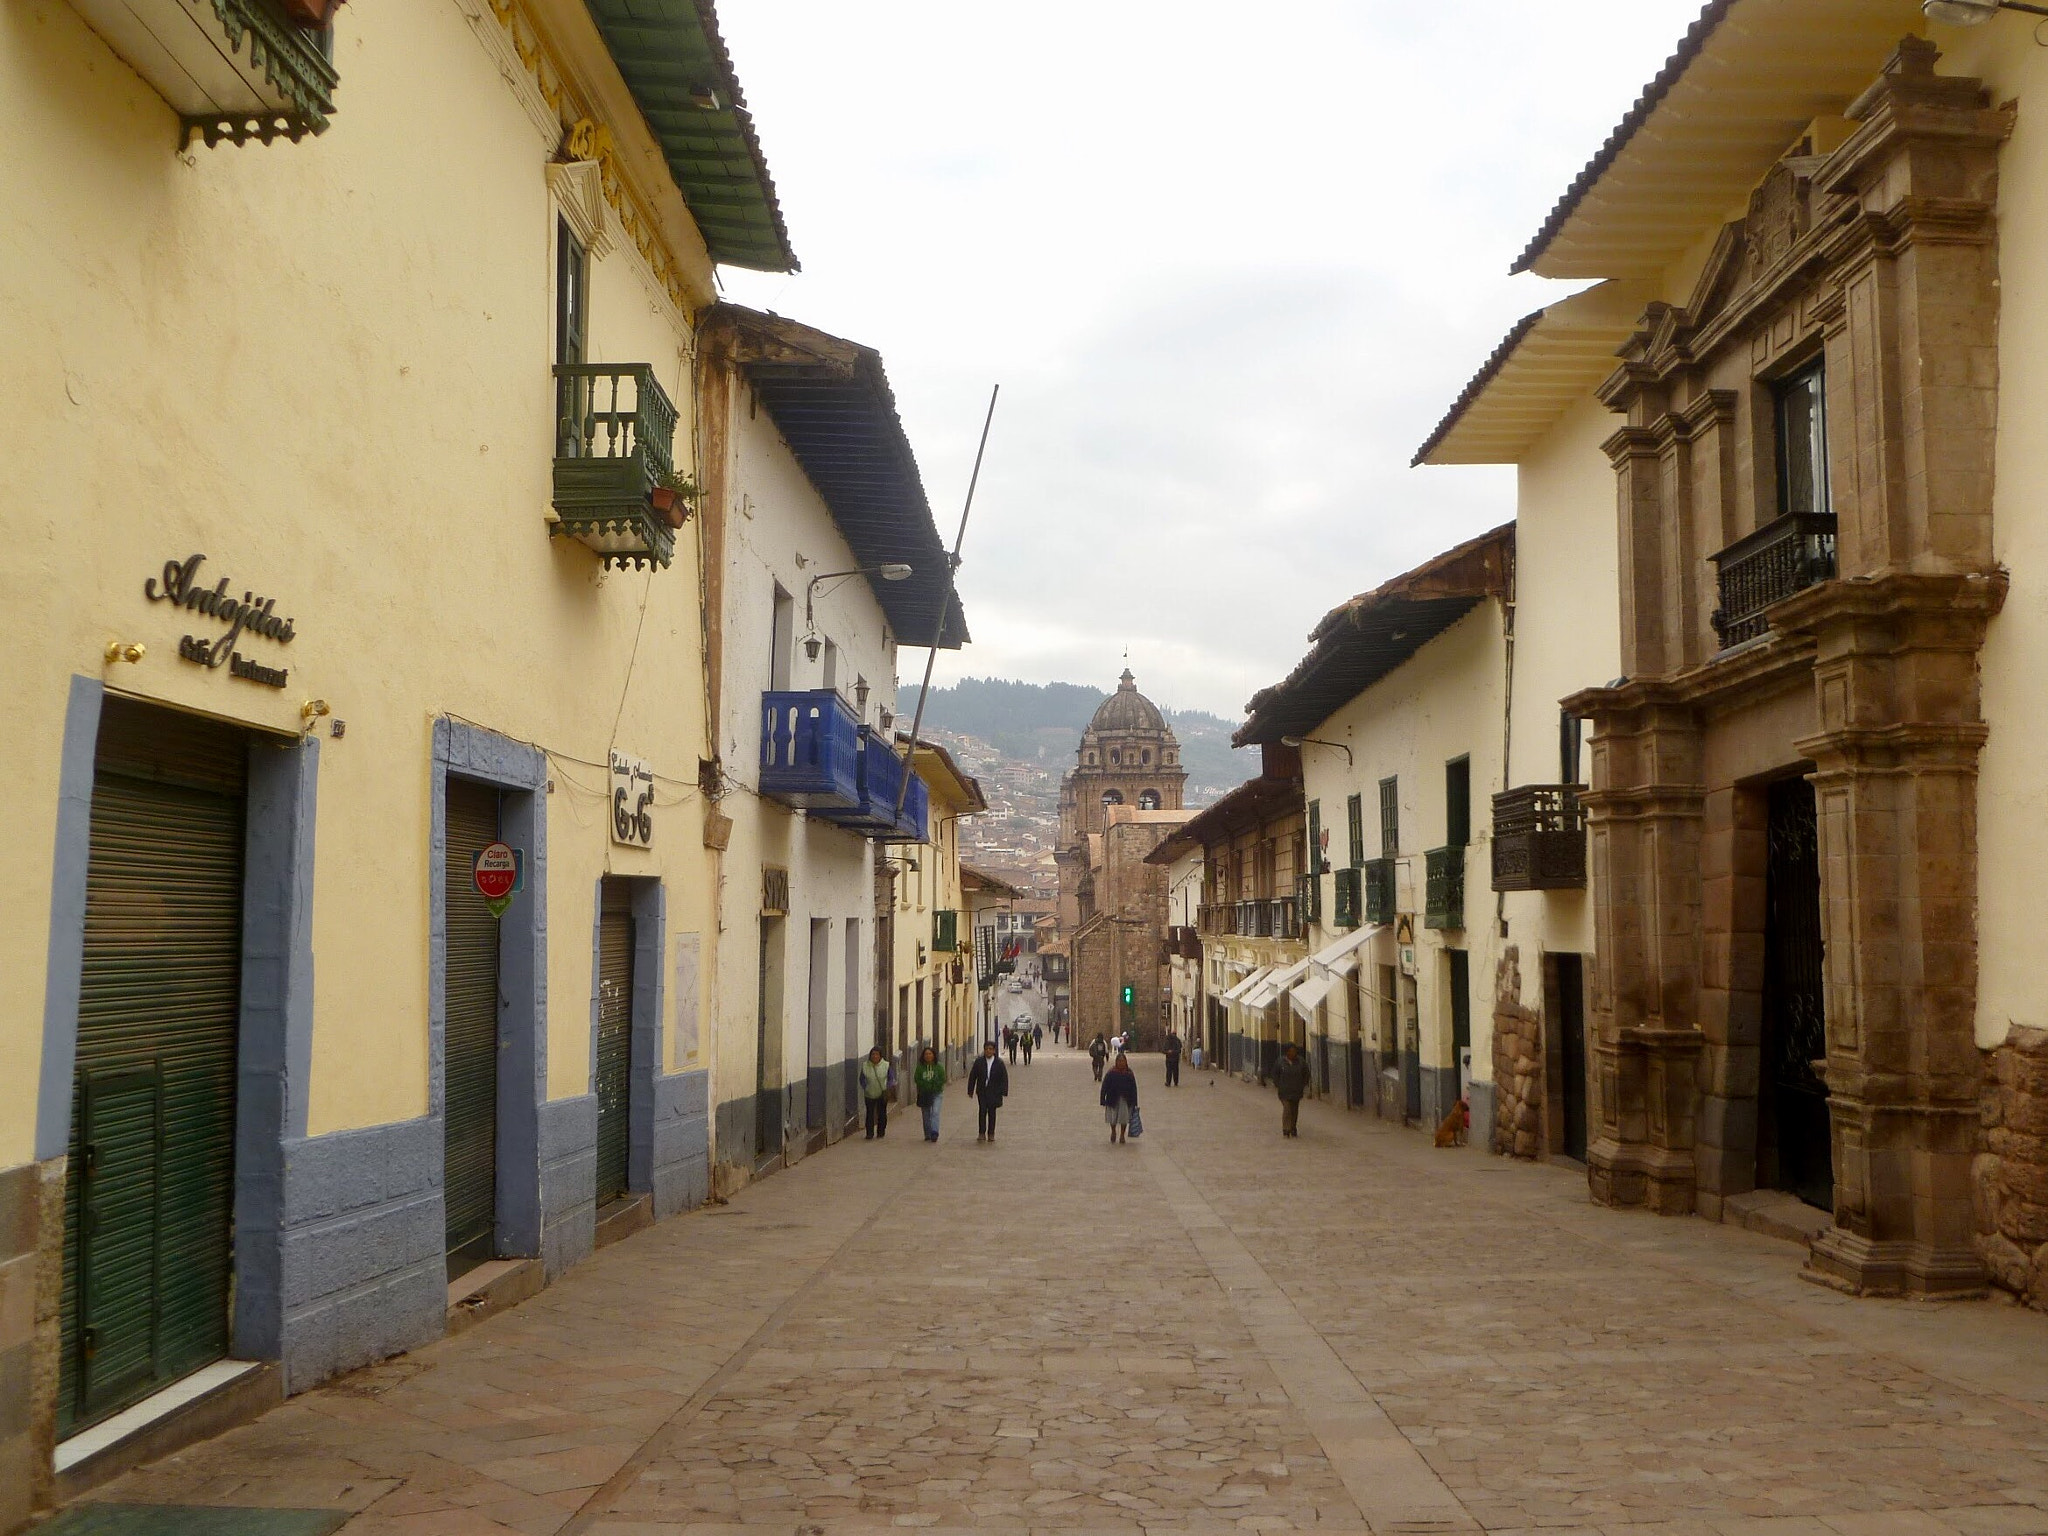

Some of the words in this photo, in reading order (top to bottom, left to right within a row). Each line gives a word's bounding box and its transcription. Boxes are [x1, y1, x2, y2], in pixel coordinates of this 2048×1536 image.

[145, 553, 297, 668] Antojitos
[487, 850, 508, 859] Claro
[484, 859, 510, 870] Recarga
